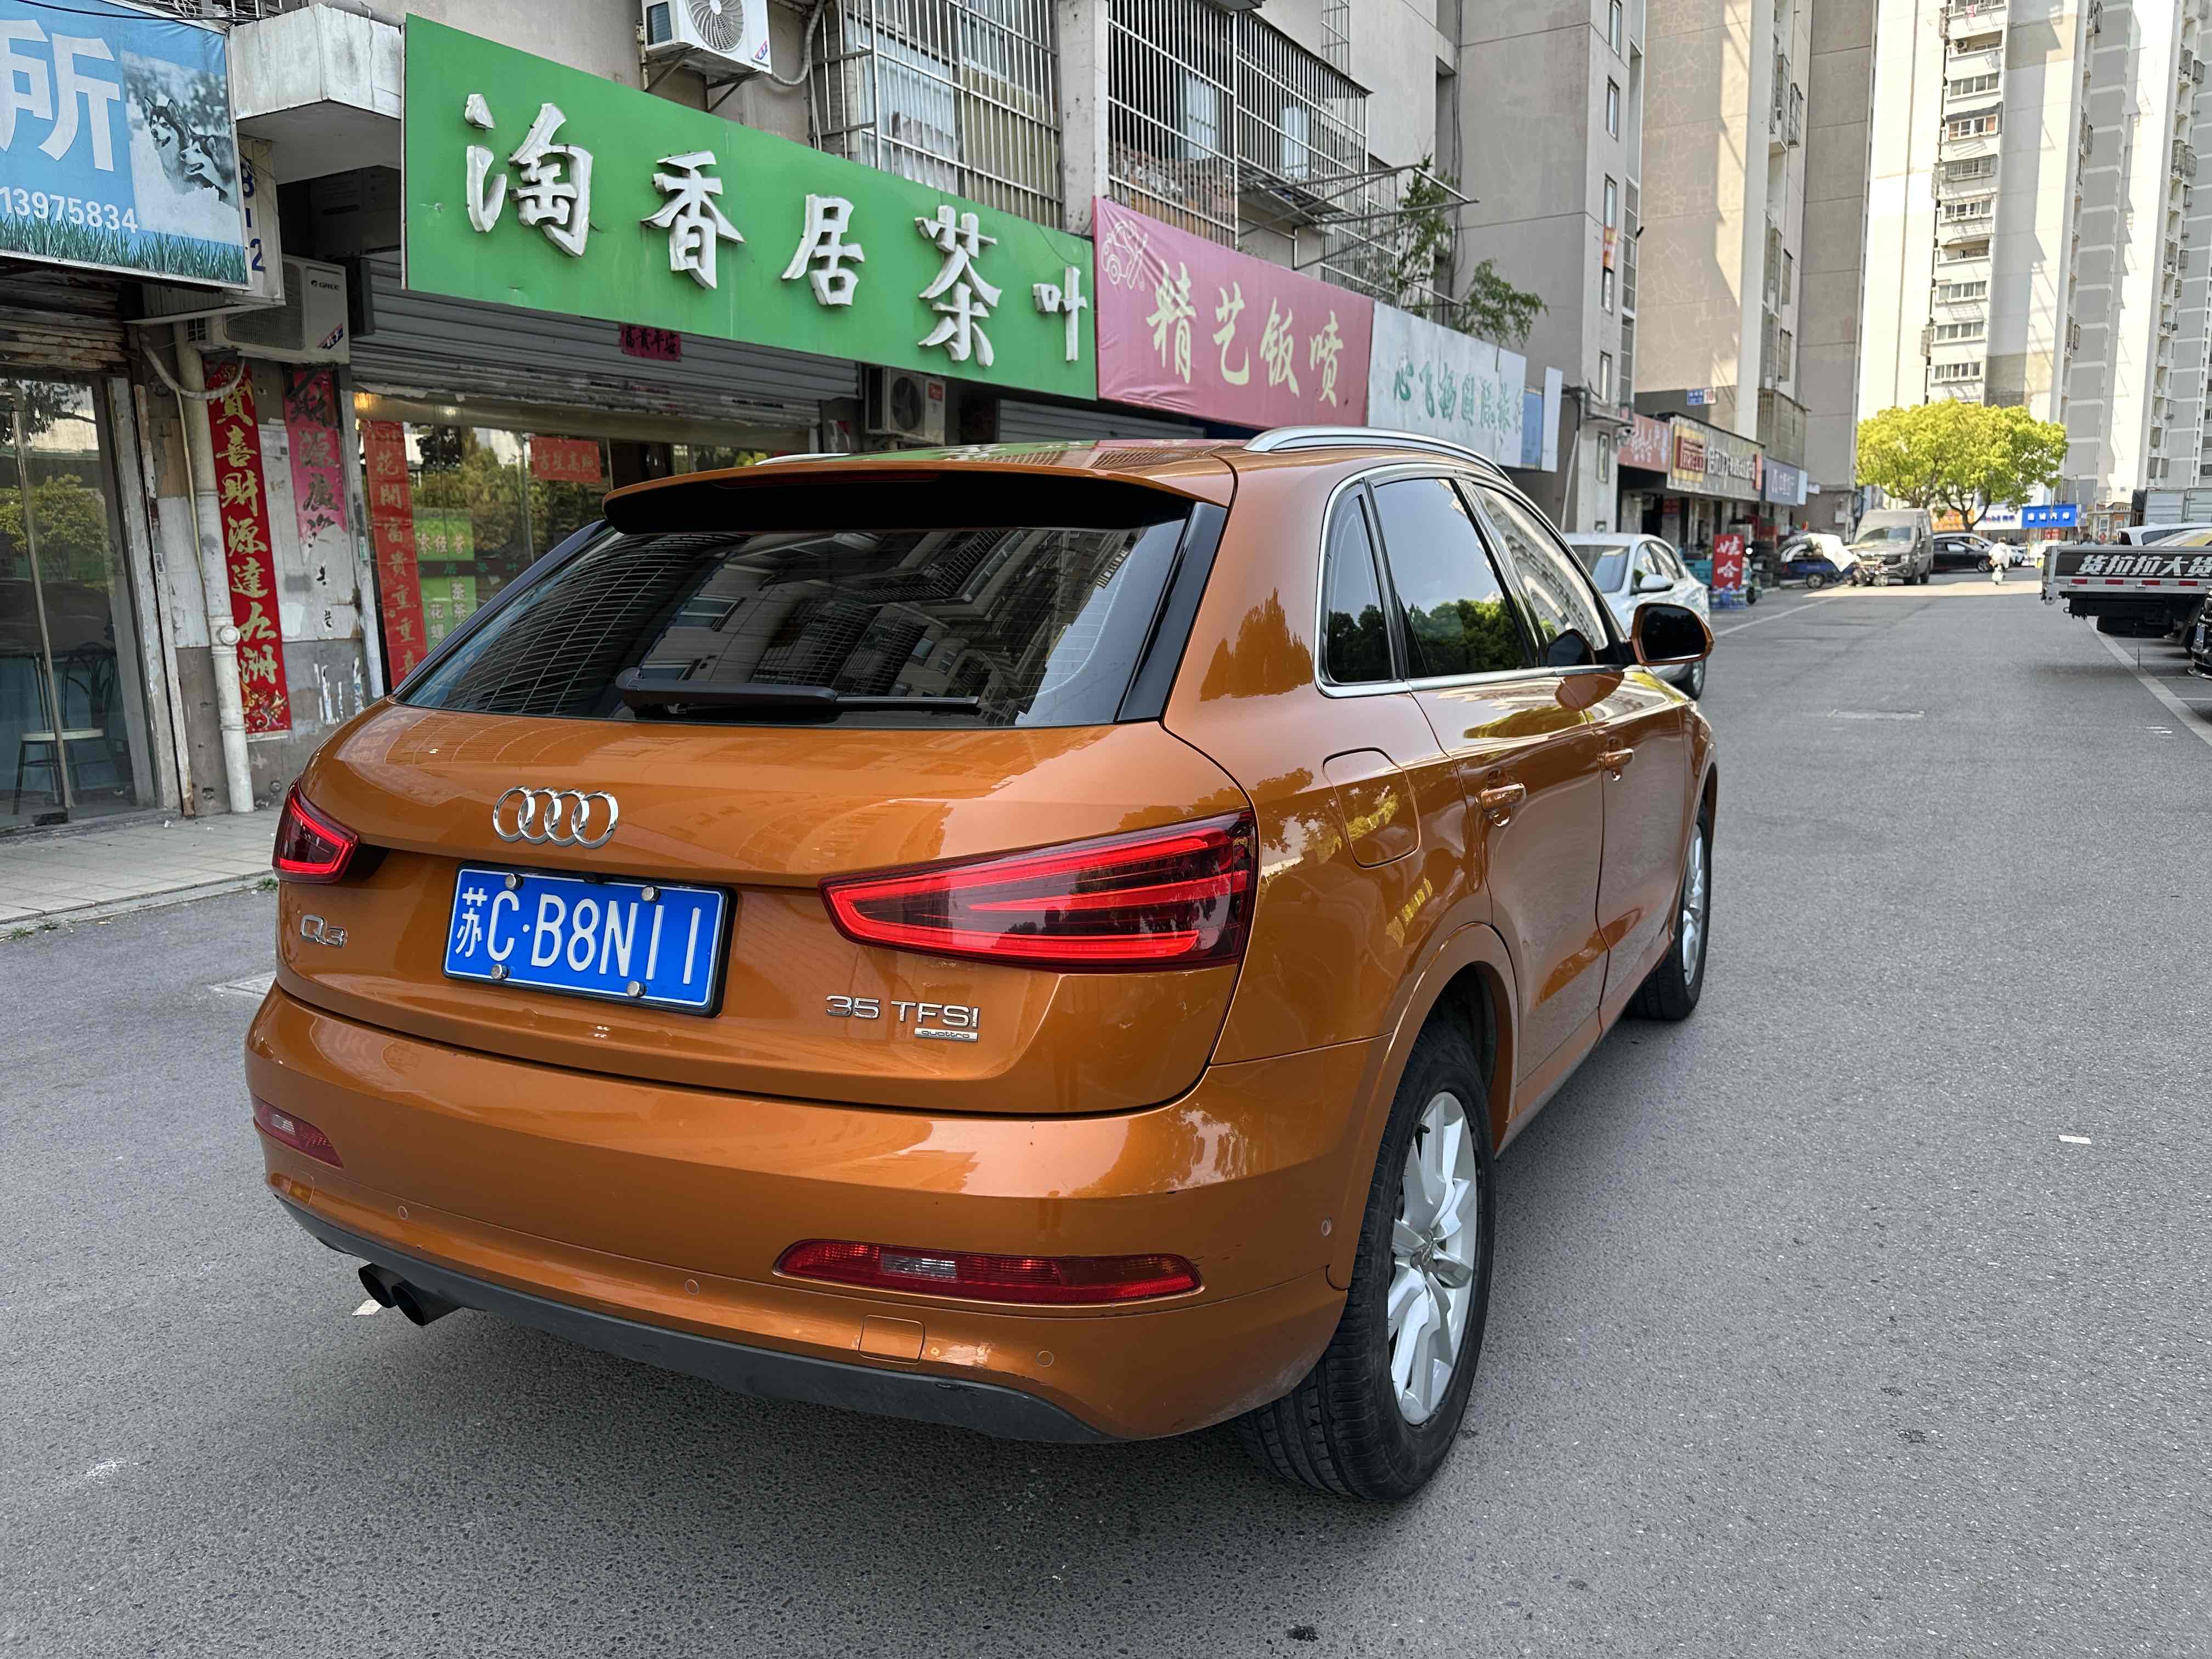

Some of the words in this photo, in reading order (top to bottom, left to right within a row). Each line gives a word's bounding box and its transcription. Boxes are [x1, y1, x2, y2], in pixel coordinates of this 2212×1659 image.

[0, 20, 121, 171] 所
[0, 188, 139, 233] 13975834
[464, 93, 1088, 366] 淘香居茶叶
[300, 914, 345, 948] Q3
[455, 887, 701, 985] 苏C·B8N11
[826, 989, 880, 1019] 35
[891, 1000, 980, 1029] TFSI
[921, 1029, 972, 1040] quattro
